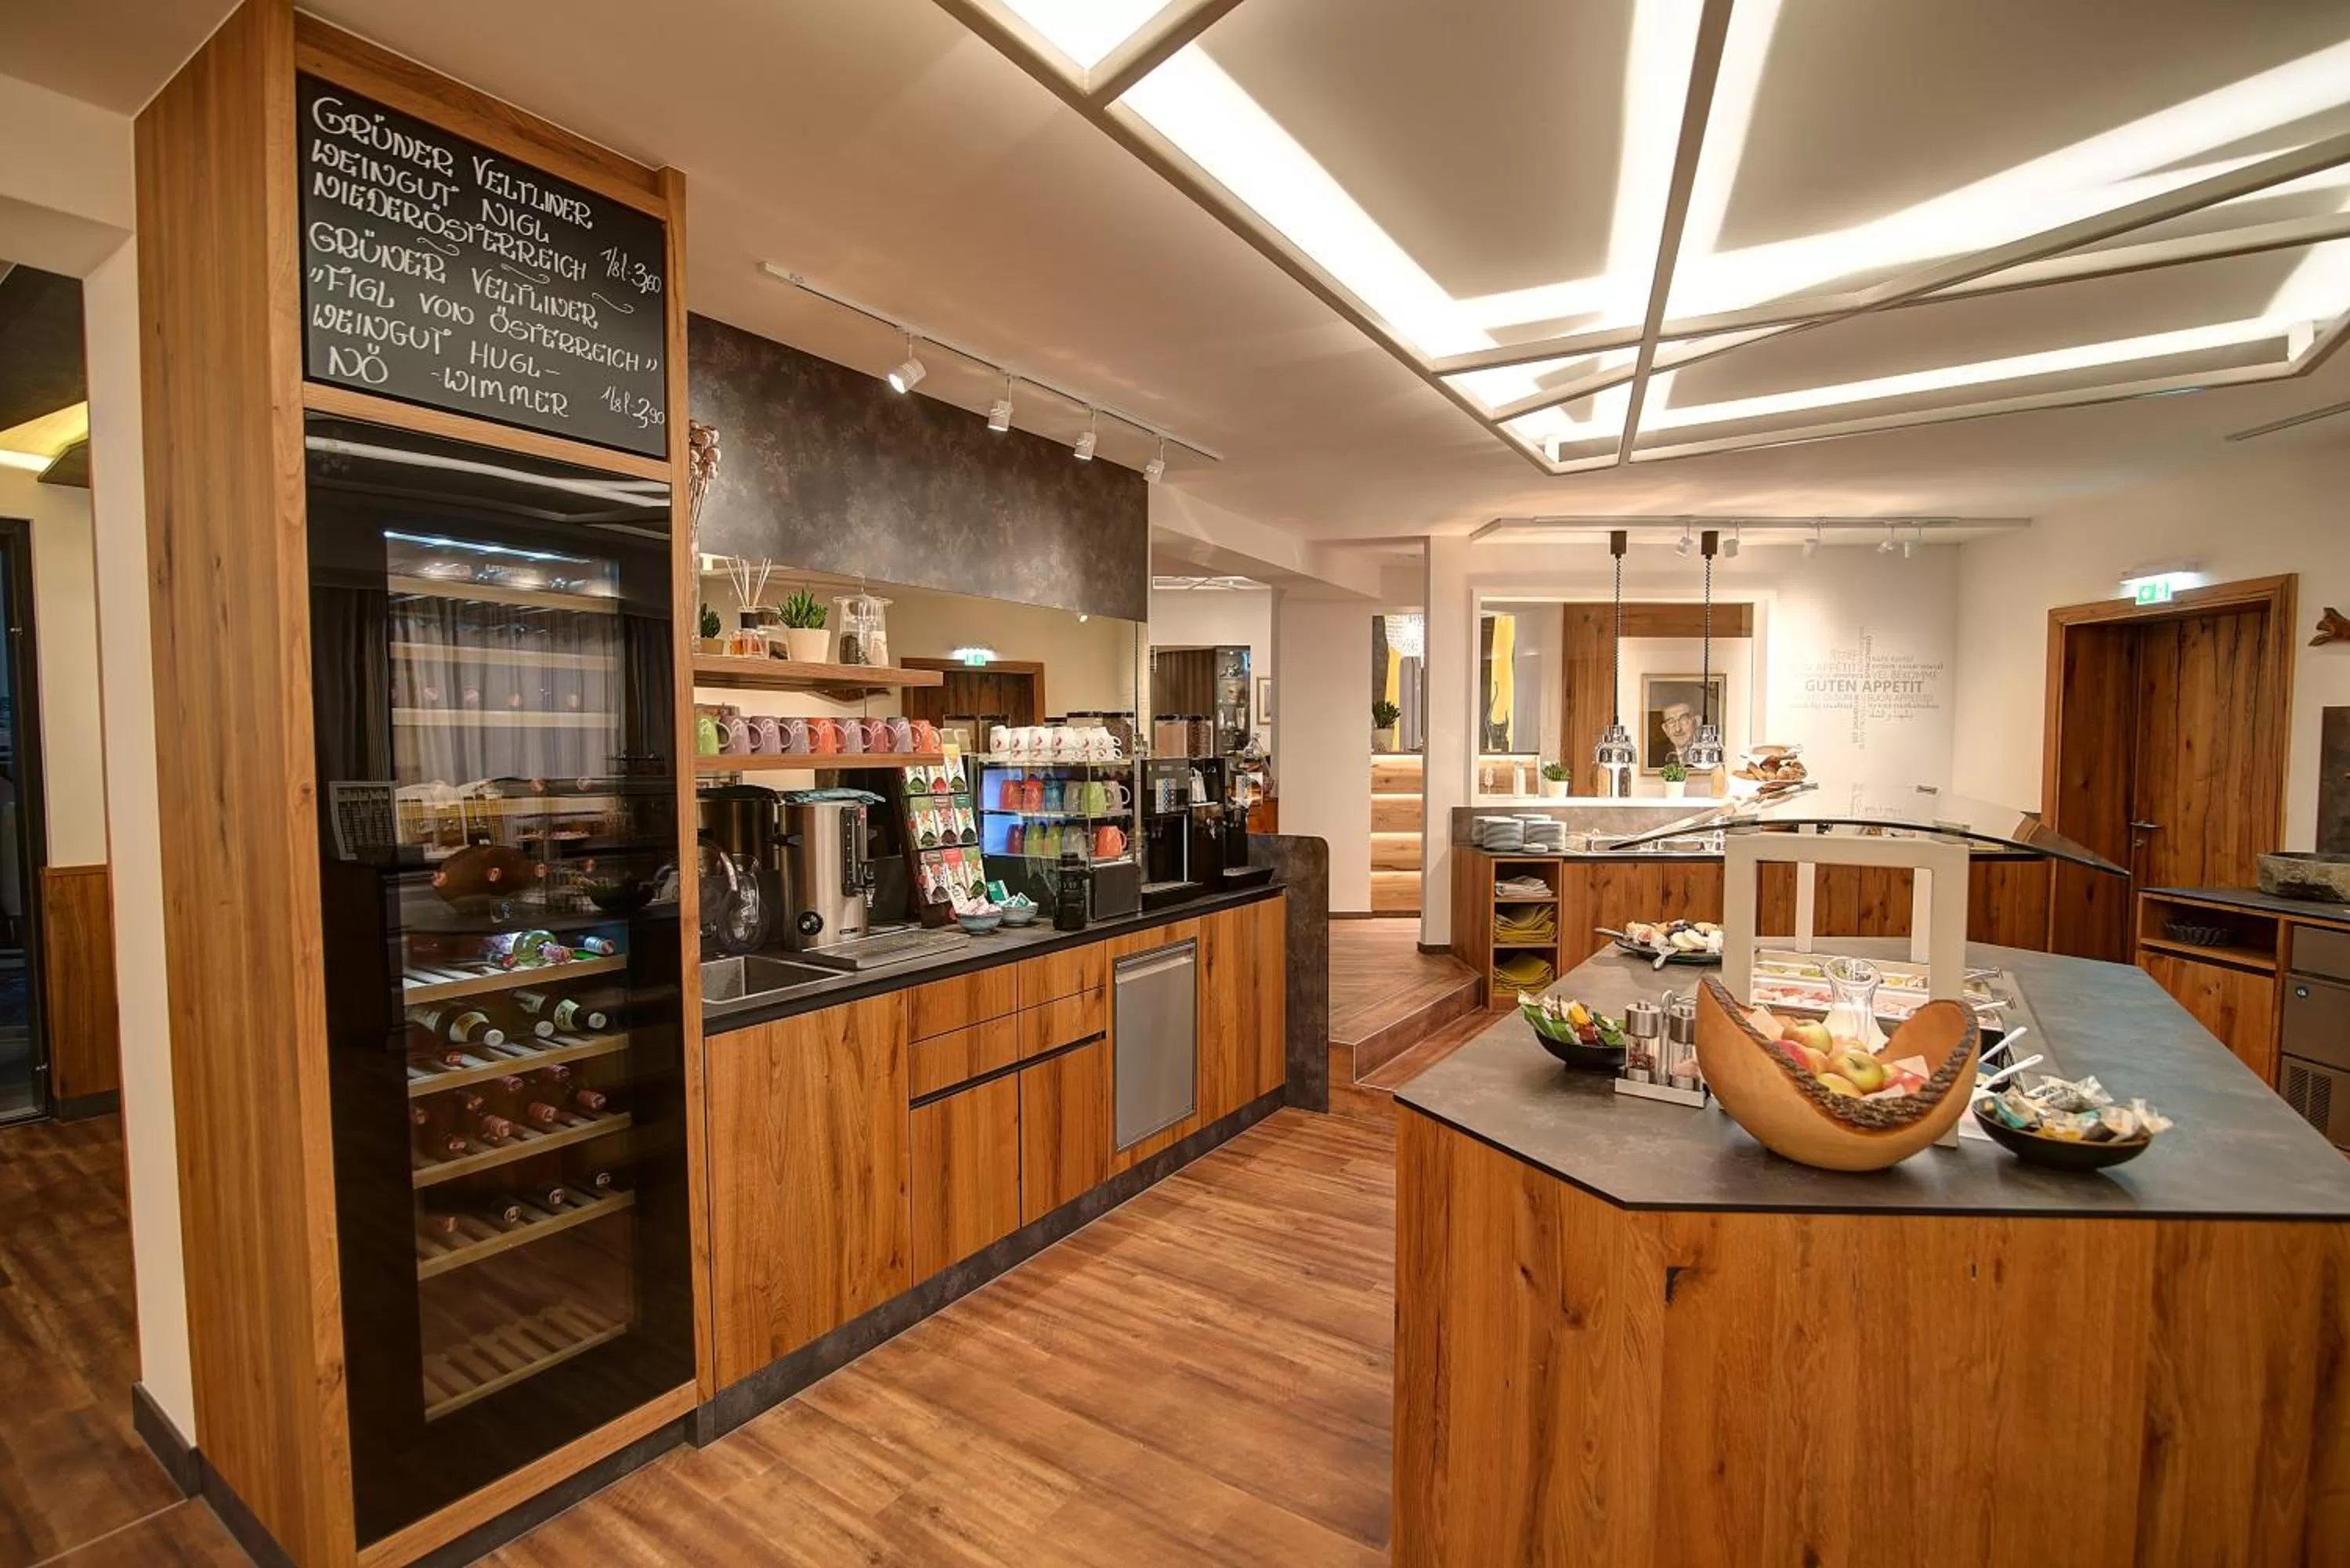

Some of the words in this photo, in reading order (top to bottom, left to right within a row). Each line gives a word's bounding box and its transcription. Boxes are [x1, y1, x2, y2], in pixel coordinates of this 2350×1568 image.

[311, 139, 460, 207] WEINGUT
[482, 198, 550, 243] NIGL
[312, 96, 454, 178] GRÜNER
[472, 156, 592, 229] VELTLINER
[313, 172, 587, 281] NIEDERÖSTERREICH
[309, 222, 446, 284] GRÜNER
[471, 267, 598, 329] VELTLINER
[419, 292, 475, 325] VON
[313, 303, 452, 355] WEINGUT
[328, 342, 389, 384] NÖ
[1805, 679, 1856, 692] GUTEN
[1863, 680, 1925, 693] APPETIT
